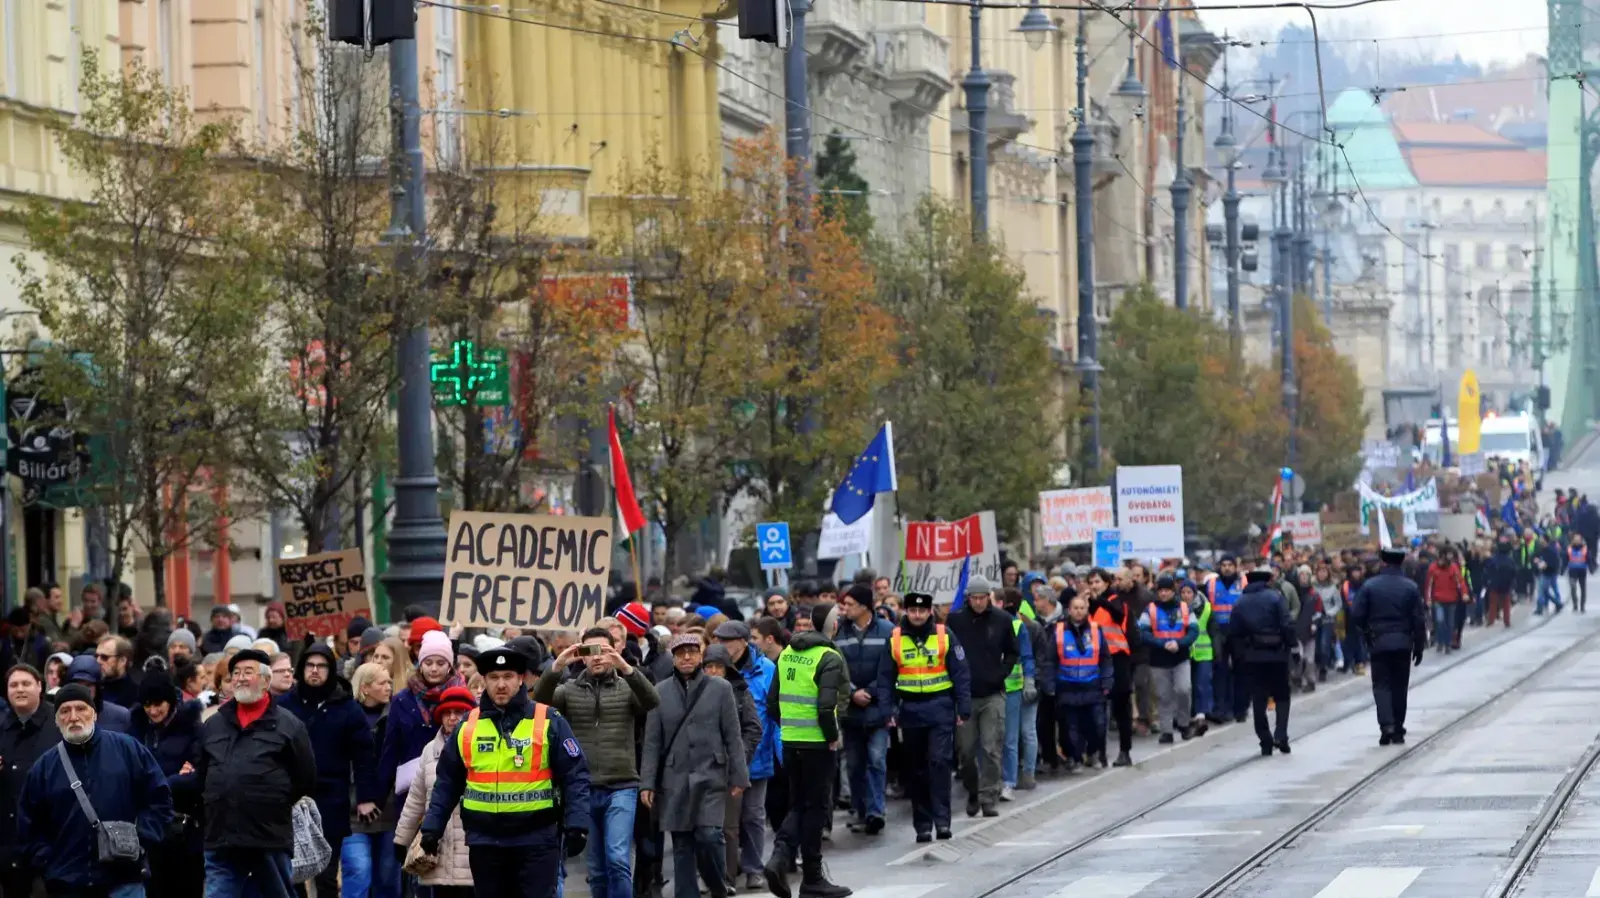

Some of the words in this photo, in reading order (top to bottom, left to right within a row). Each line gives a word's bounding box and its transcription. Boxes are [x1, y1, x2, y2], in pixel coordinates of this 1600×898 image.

[1129, 513, 1175, 524] EGYETEMIG
[451, 521, 608, 575] ACADEMIC
[915, 521, 971, 557] NEM
[279, 558, 343, 584] RESPECT
[292, 574, 366, 600] EXISTENZ
[446, 571, 602, 627] FREEDOM
[285, 596, 344, 617] EXPECT
[787, 667, 797, 681] 30
[490, 793, 525, 801] POLICE
